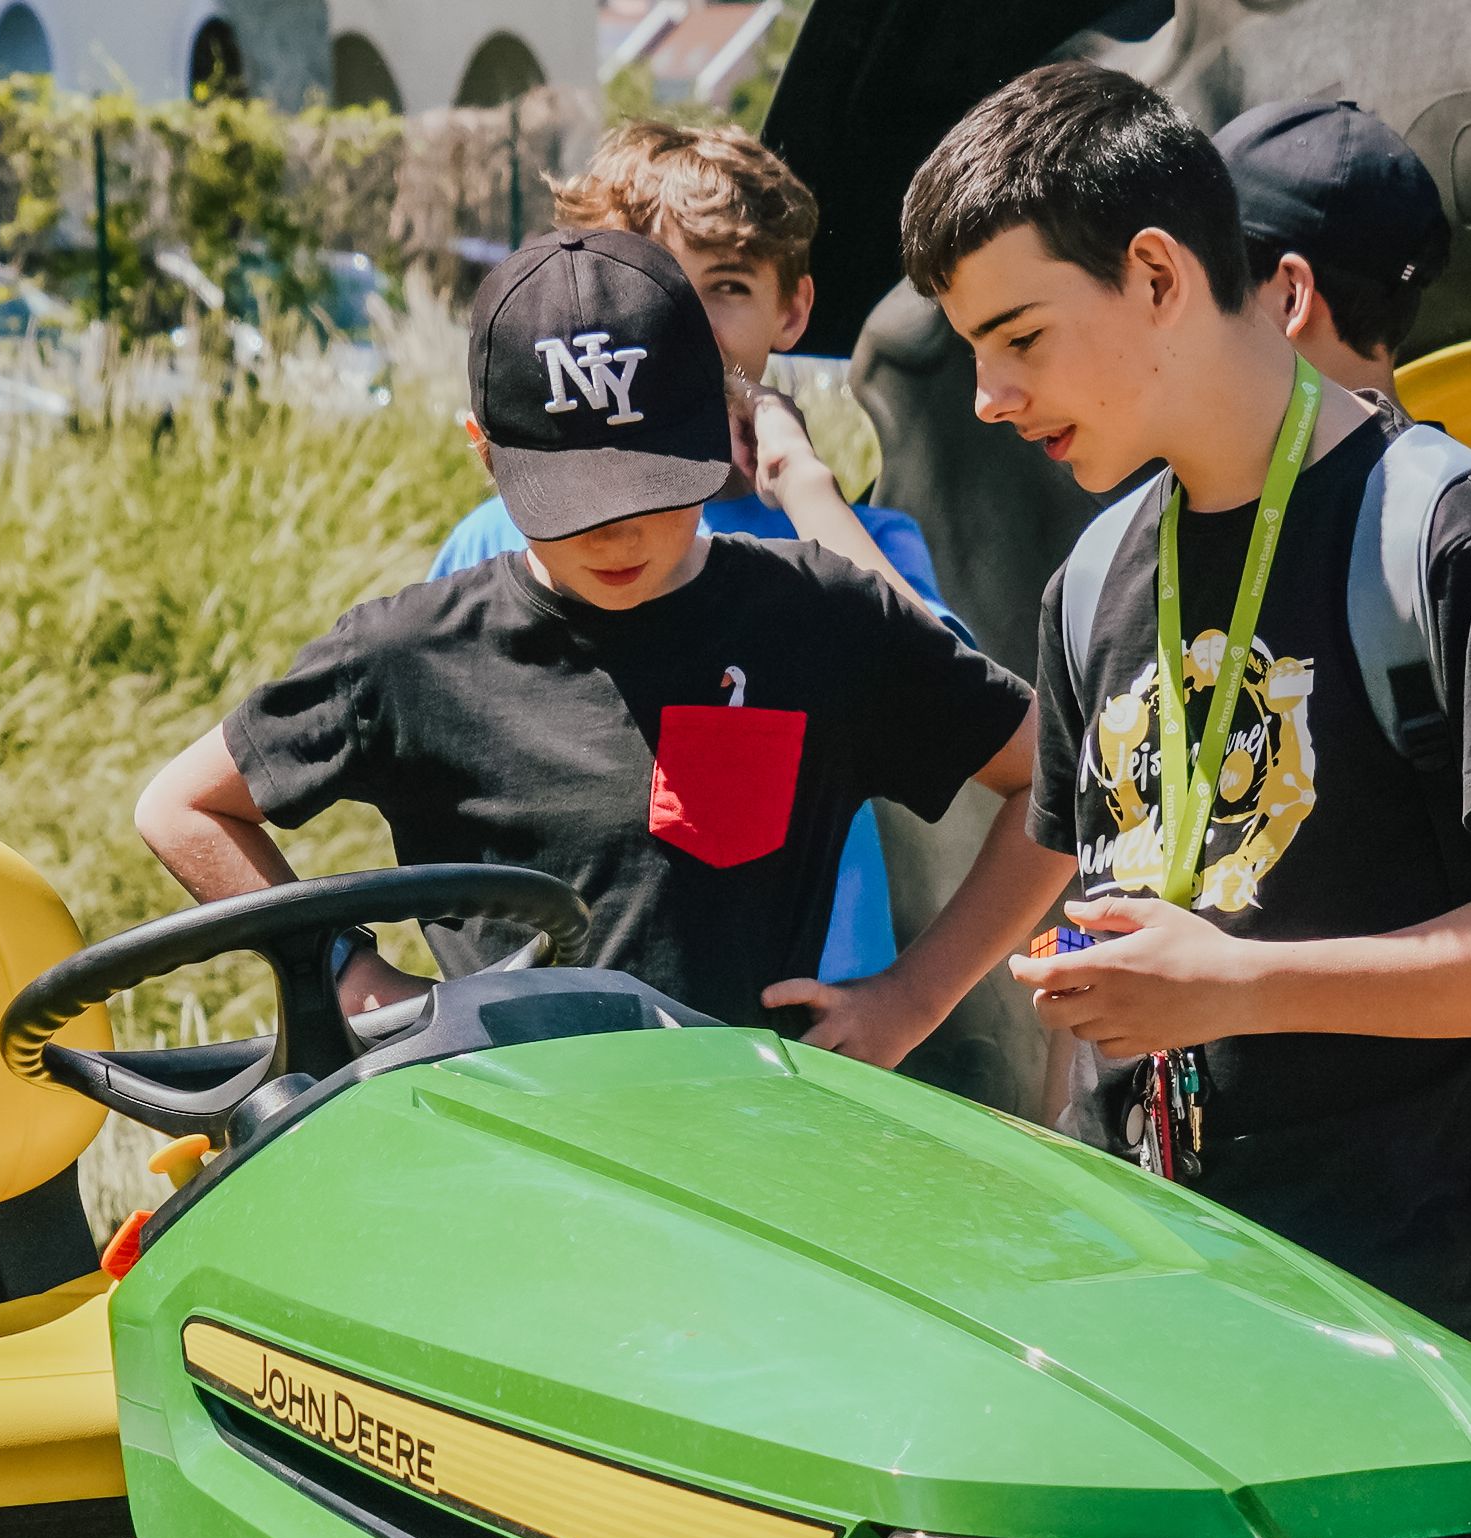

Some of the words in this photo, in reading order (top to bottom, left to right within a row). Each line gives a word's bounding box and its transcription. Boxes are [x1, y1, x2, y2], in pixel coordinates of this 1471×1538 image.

[534, 331, 648, 426] NY
[1297, 394, 1316, 430] Banka
[1288, 428, 1307, 464] Prima
[1259, 524, 1276, 562] Banka
[1251, 561, 1270, 597] Prima
[1163, 682, 1174, 721] Banka
[1217, 700, 1232, 734] Prima
[1225, 661, 1243, 701] Banka
[1167, 784, 1177, 818] Prima
[1166, 817, 1178, 858] Banka
[1182, 836, 1200, 871] Prima
[1191, 799, 1209, 838] Banka
[253, 1353, 326, 1433] JOHN
[333, 1389, 436, 1486] DEERE
